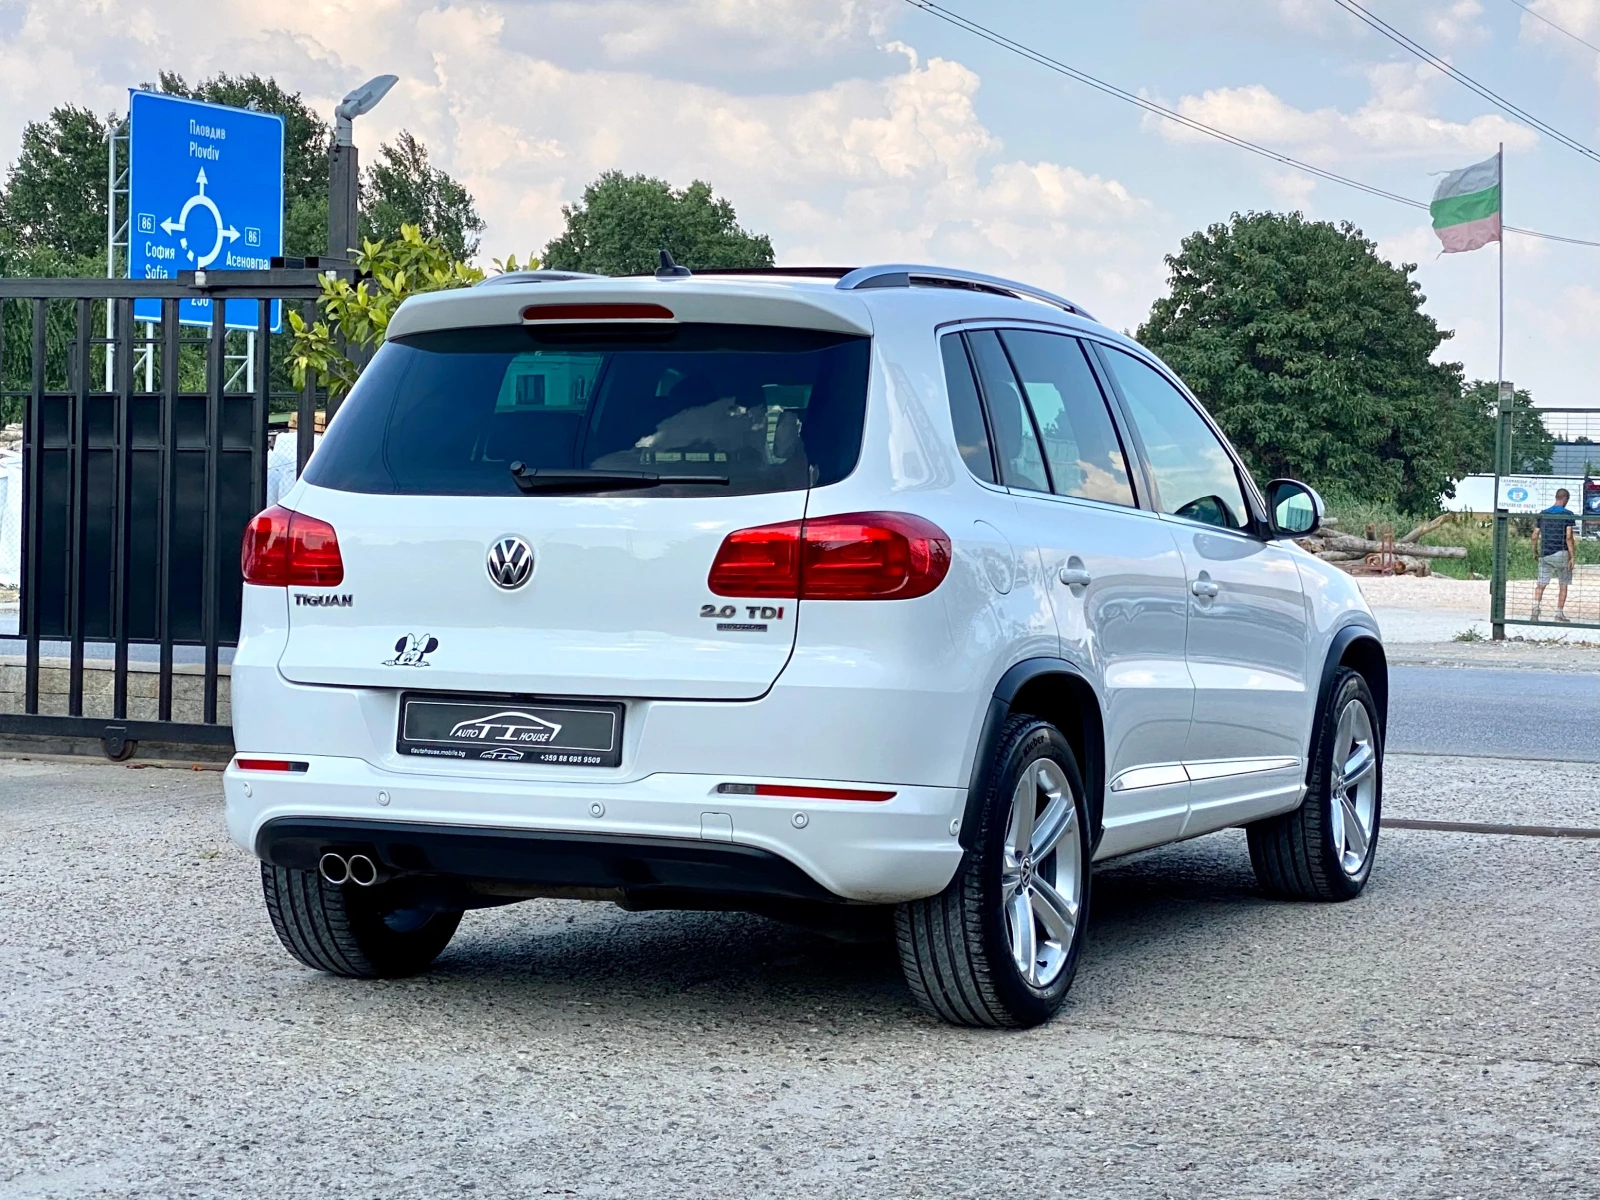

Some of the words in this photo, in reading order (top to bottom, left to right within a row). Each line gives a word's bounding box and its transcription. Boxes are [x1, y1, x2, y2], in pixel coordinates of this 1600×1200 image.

[189, 119, 226, 140] Пловдив
[189, 141, 220, 161] Plovdiv
[141, 216, 152, 230] 86
[248, 231, 257, 243] 86
[145, 241, 175, 260] София
[226, 251, 271, 271] Асеновгра
[145, 264, 168, 279] Sofia
[294, 593, 353, 607] TIGUAN
[700, 604, 736, 619] 2.0
[745, 606, 784, 620] TDI
[455, 728, 479, 738] AUTO
[518, 732, 550, 742] HOUSE
[540, 754, 557, 762] +359
[568, 755, 582, 763] 695
[583, 756, 601, 764] 9509
